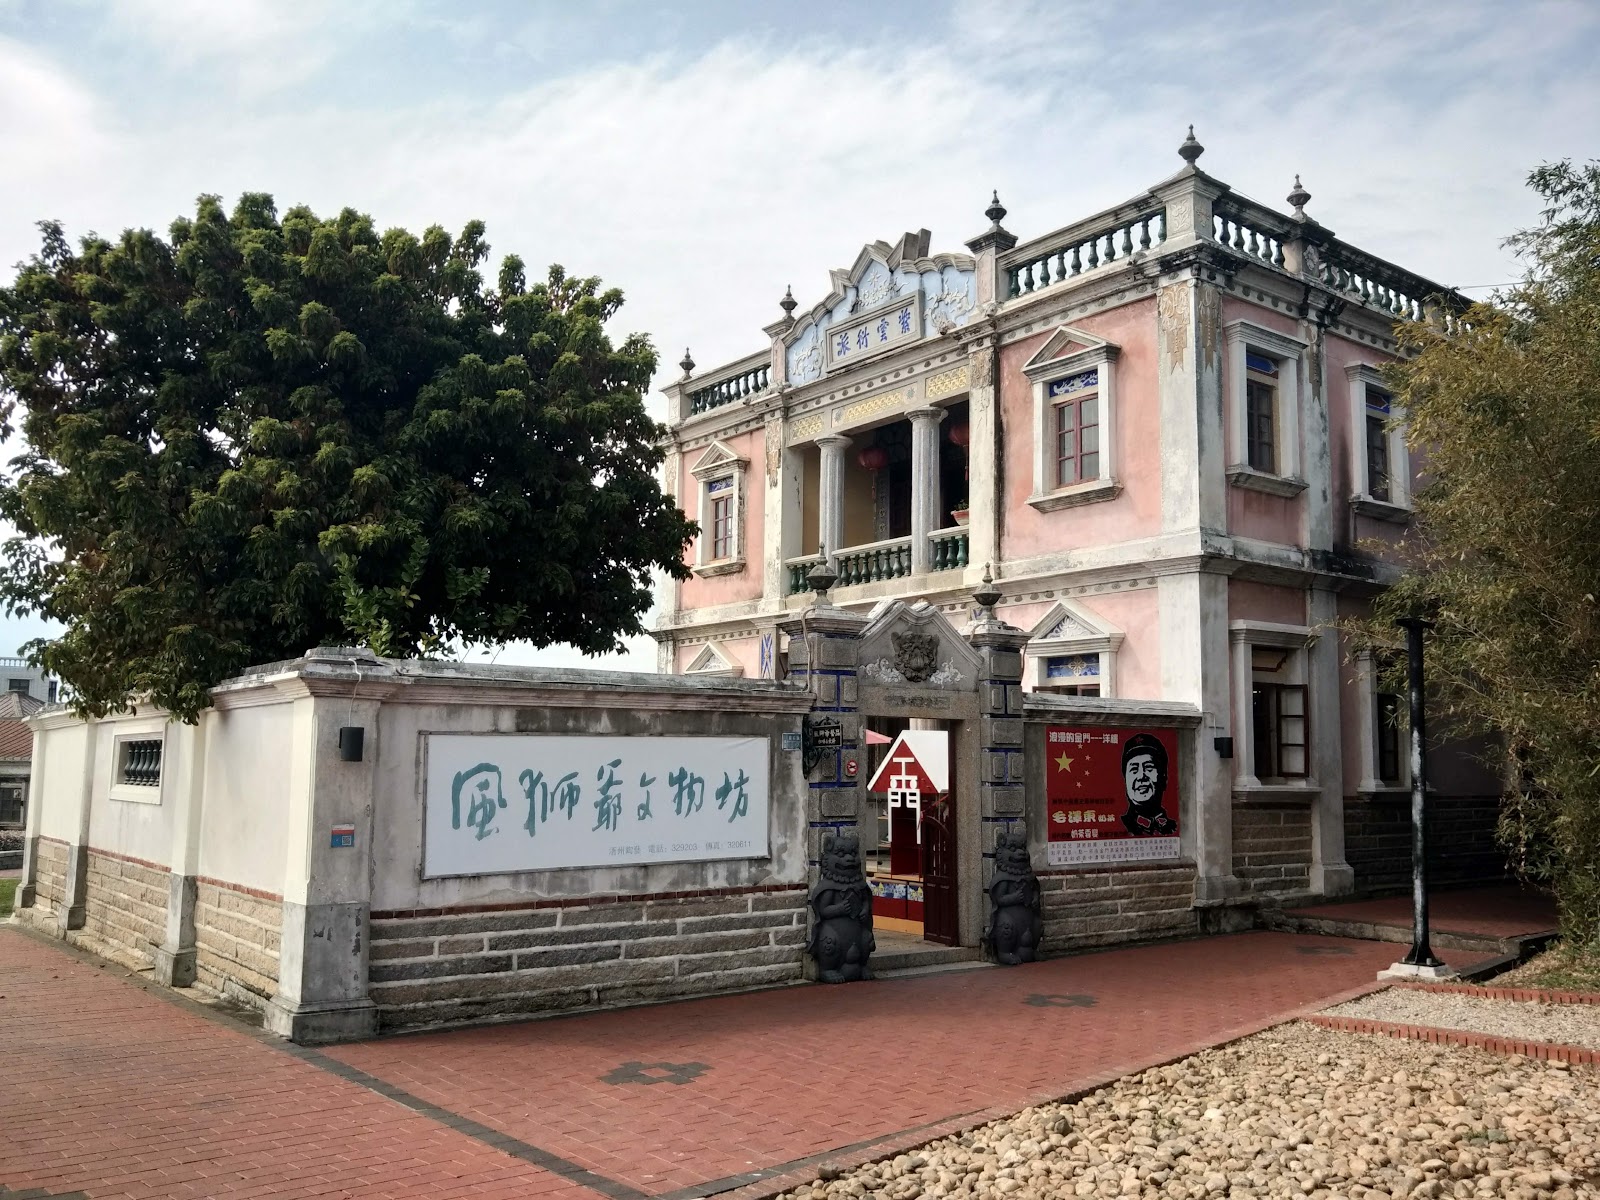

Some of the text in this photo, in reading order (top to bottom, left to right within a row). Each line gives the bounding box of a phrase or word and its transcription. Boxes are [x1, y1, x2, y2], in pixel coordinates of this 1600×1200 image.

[451, 758, 750, 841] 風獅爺文物坊
[671, 843, 698, 852] 329203
[727, 840, 751, 849] 320611
